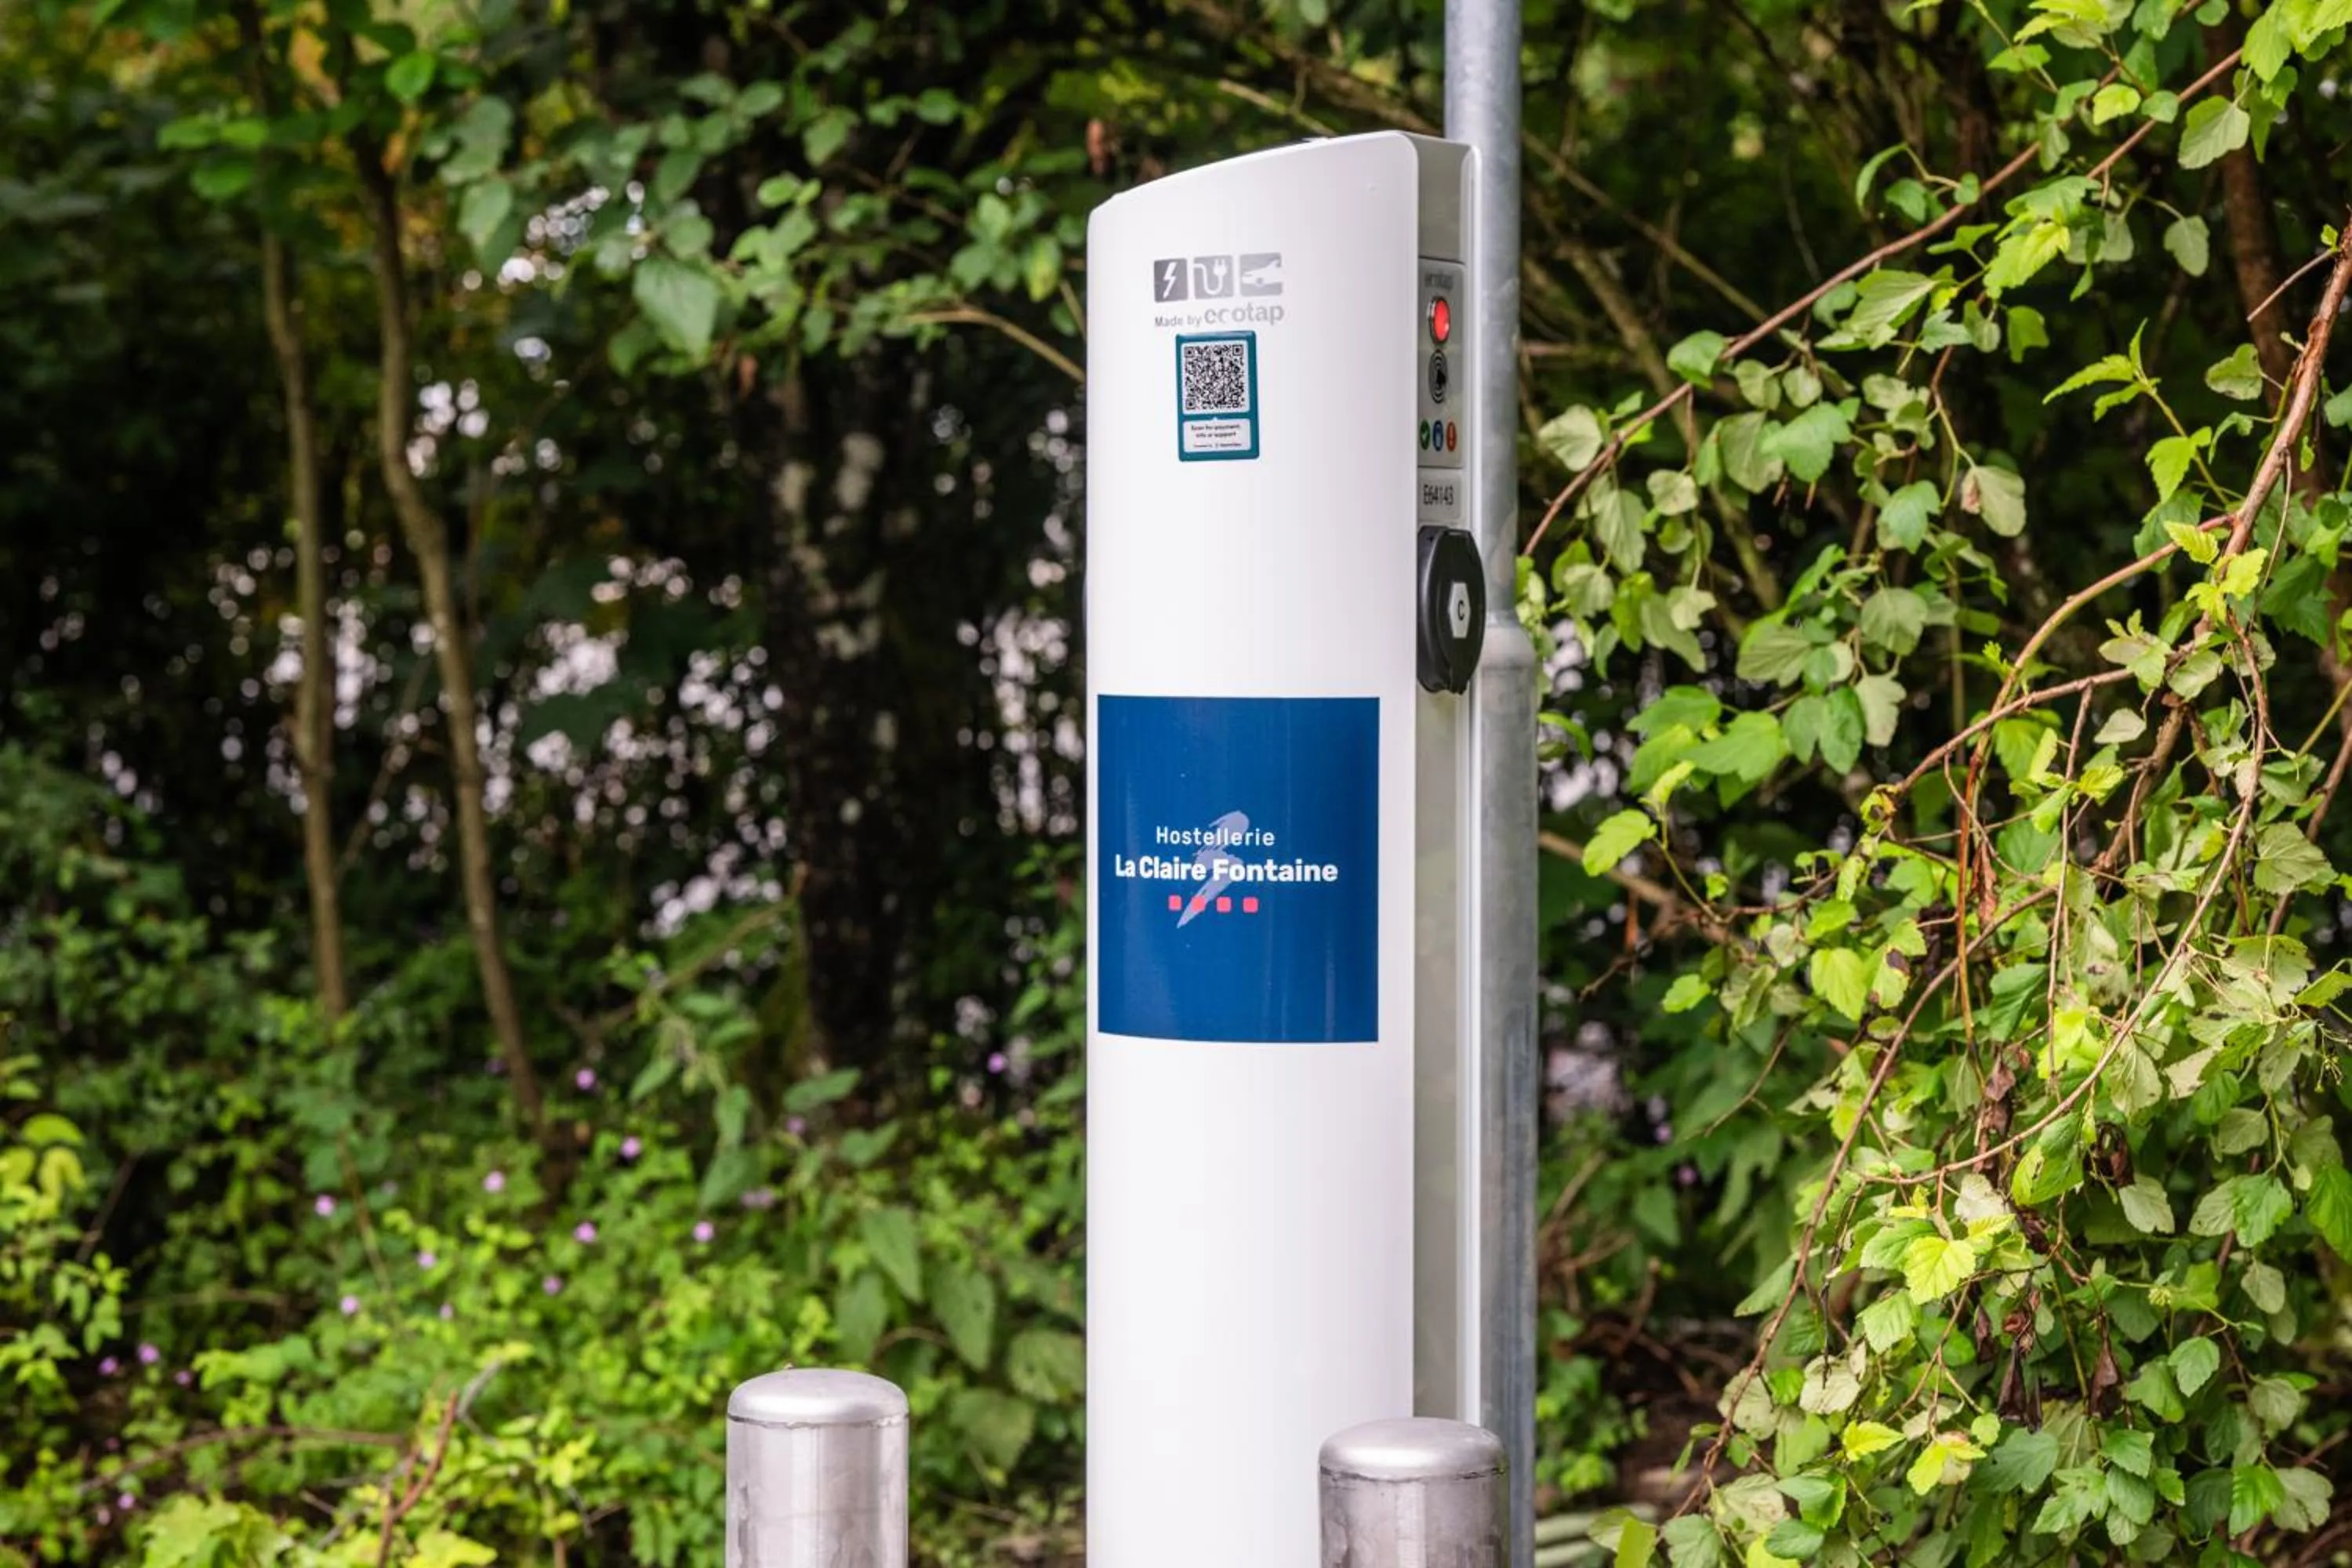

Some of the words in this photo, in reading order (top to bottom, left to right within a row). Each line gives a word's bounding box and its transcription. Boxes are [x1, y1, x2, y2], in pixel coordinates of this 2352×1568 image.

[1154, 316, 1184, 327] Made
[1187, 314, 1203, 327] by
[1204, 302, 1285, 325] ecotap
[1423, 485, 1454, 506] E64143
[1457, 600, 1465, 621] C
[1156, 826, 1276, 847] Hostellerie
[1115, 854, 1136, 879] La
[1139, 855, 1207, 880] Claire
[1213, 858, 1339, 883] Fontaine
